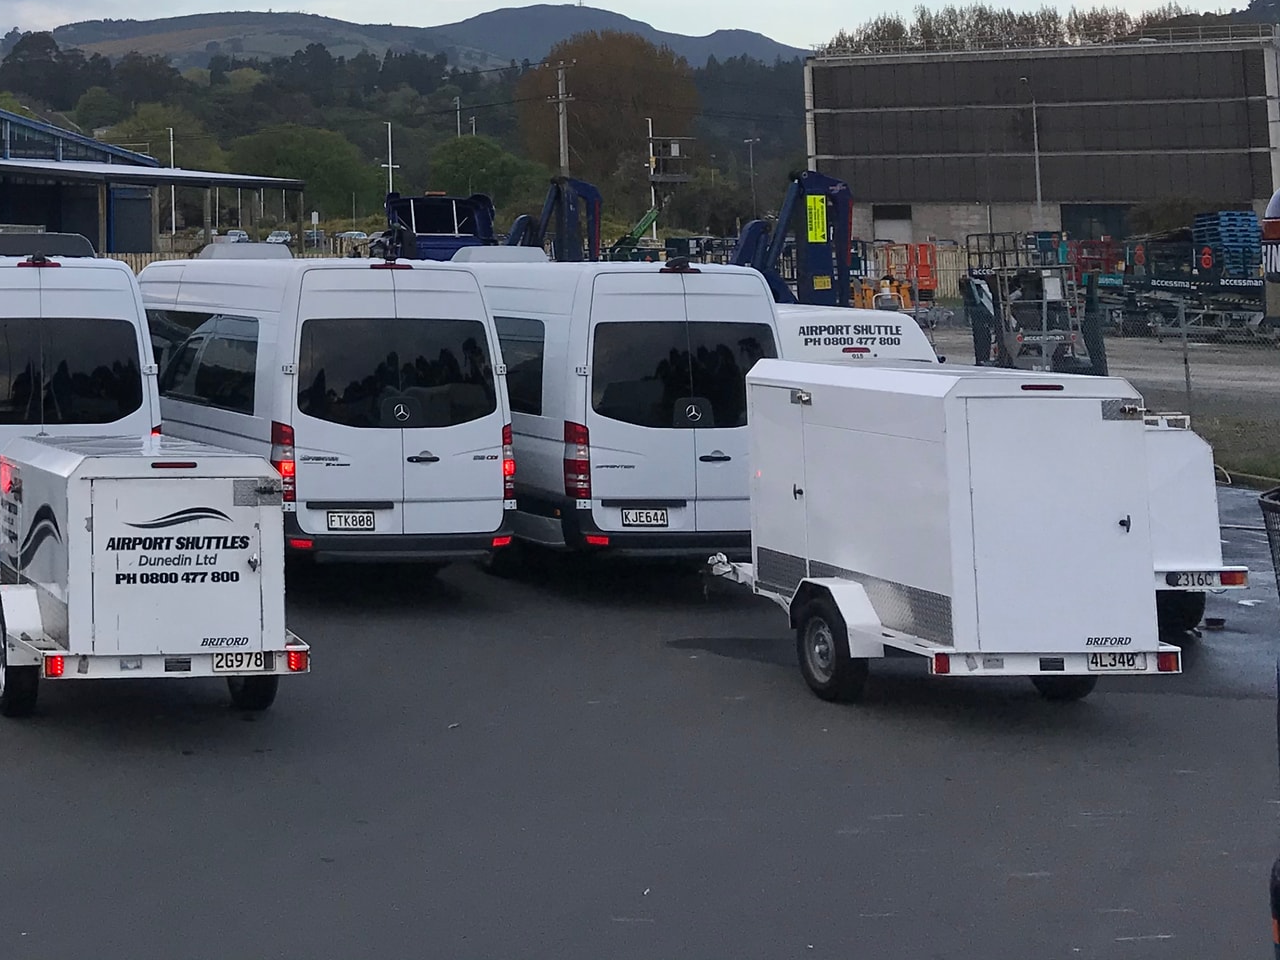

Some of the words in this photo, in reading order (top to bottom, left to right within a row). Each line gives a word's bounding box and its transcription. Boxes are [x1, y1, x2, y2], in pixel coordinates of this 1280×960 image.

[1151, 279, 1190, 288] accessma
[1220, 278, 1263, 287] accessman
[799, 325, 851, 336] AIRPORT
[853, 325, 902, 335] SHUTTLE
[804, 337, 821, 346] PH
[823, 337, 854, 345] 0800
[856, 337, 876, 345] 477
[879, 337, 900, 345] 800
[329, 515, 372, 527] FTK808
[624, 511, 666, 524] KJE644
[106, 537, 174, 551] AIRPORT
[175, 536, 250, 550] SHUTTLES
[138, 554, 192, 566] Dunedin
[195, 554, 218, 565] Ltd
[115, 573, 137, 584] PH
[139, 572, 178, 584] 0800
[181, 572, 208, 583] 477
[211, 571, 240, 582] 800
[201, 637, 249, 647] BRIFORD
[1086, 637, 1131, 646] BRIFORD
[215, 652, 263, 669] 2G978
